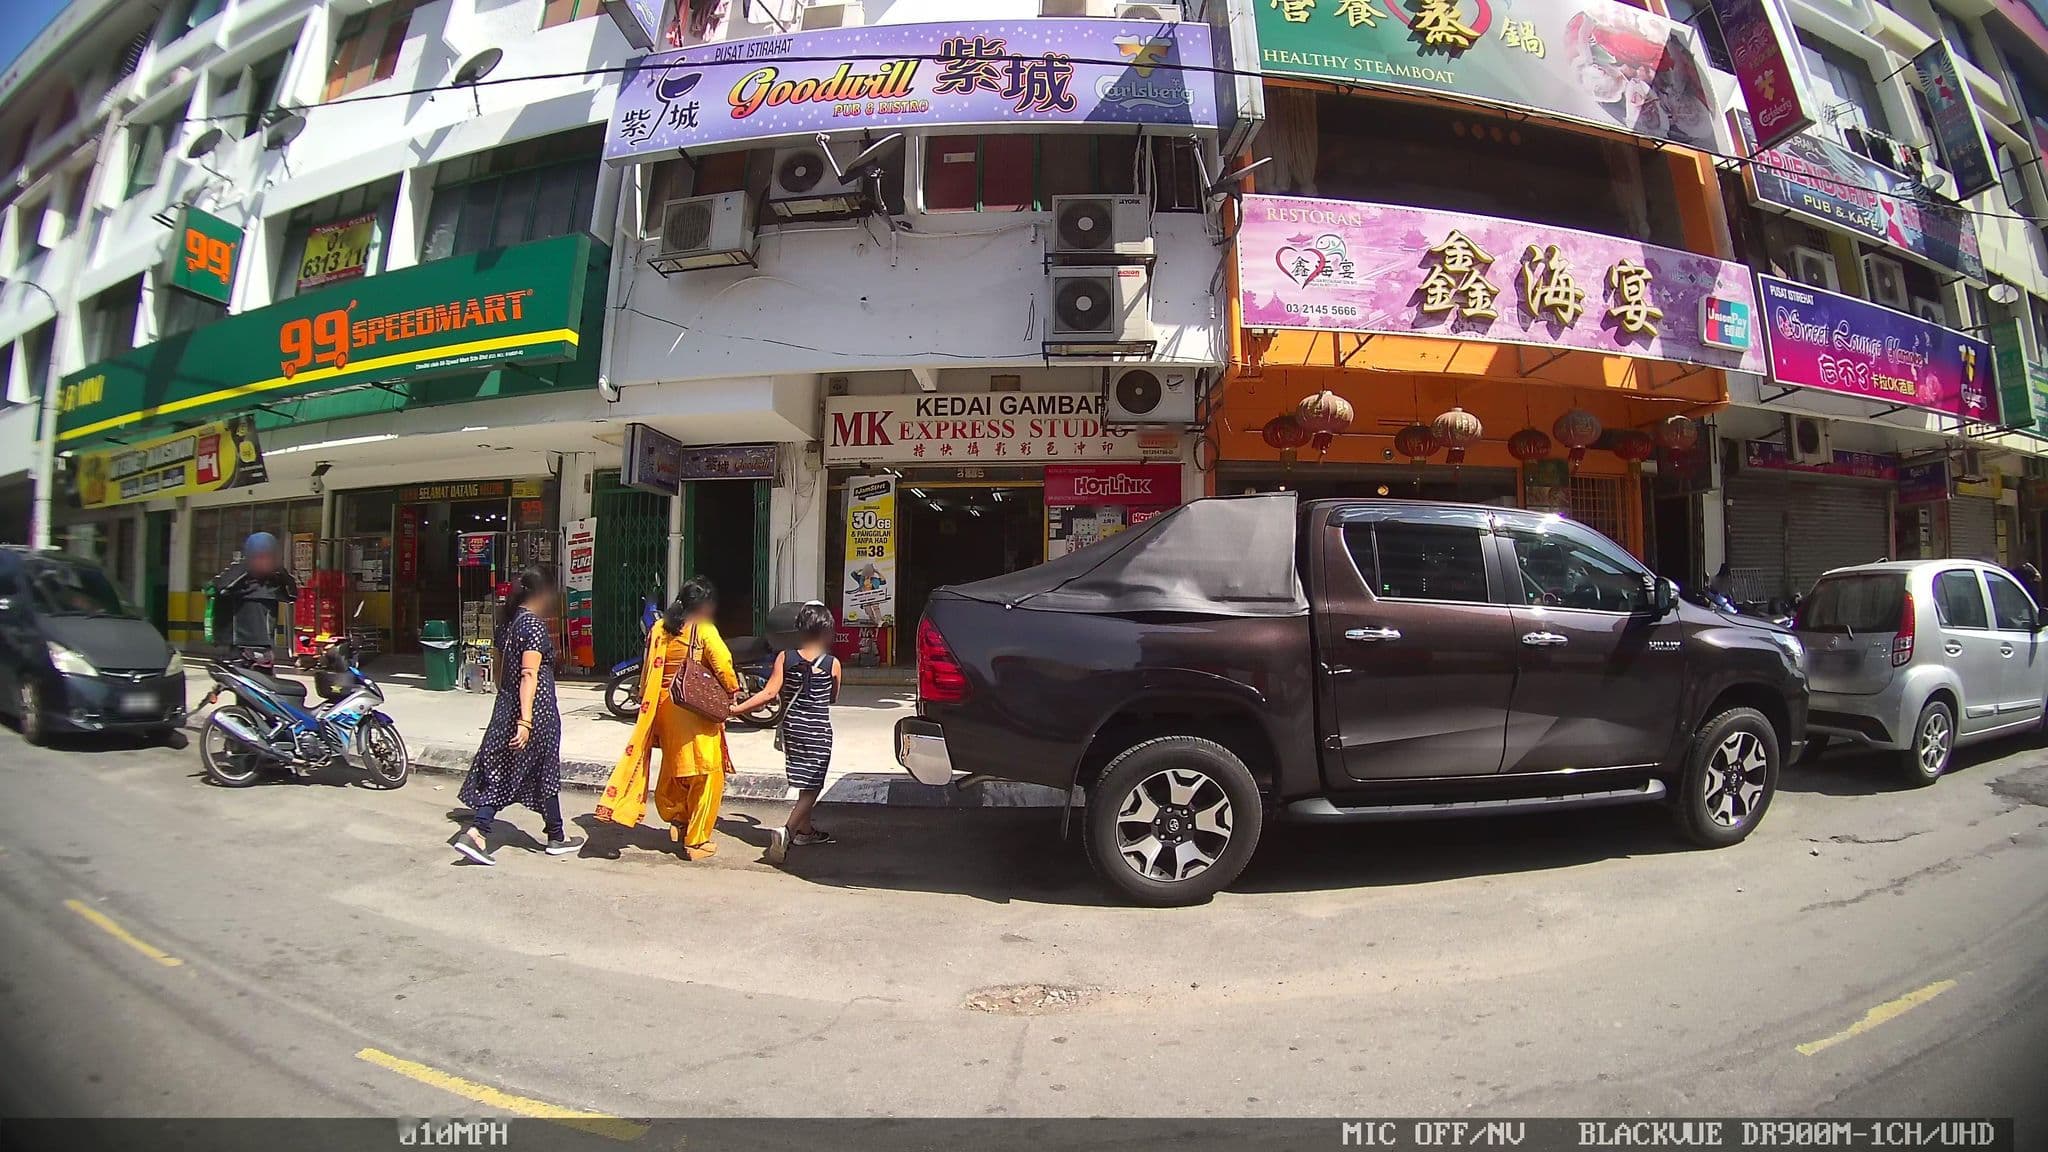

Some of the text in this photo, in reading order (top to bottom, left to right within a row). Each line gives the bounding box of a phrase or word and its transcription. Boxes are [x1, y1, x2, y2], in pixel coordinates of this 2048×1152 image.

[715, 38, 794, 61] PUSAT ISTIRAHAT
[931, 35, 1078, 113] 紫城
[1263, 49, 1456, 85] HEALTHY STEAMBOAT
[727, 59, 923, 120] Goodwill
[1094, 75, 1195, 109] Carlsberg
[833, 102, 860, 117] PUB
[878, 100, 930, 115] BISTRO
[1803, 194, 1832, 214] PUB
[1267, 208, 1361, 226] RESTORAN
[185, 228, 237, 285] 99
[1420, 229, 1664, 338] 鑫海宴
[1286, 303, 1357, 316] 03 2145 5666
[1707, 307, 1747, 329] UnionPay
[280, 289, 528, 380] 99 SPEEDMART
[916, 397, 992, 417] KEDAI
[830, 410, 895, 447] MK
[898, 418, 1016, 441] EXPRESS
[418, 485, 450, 500] SELAMAT
[450, 483, 479, 498] DATANG
[854, 537, 874, 545] TANPA
[857, 530, 891, 538] PANGGILAN
